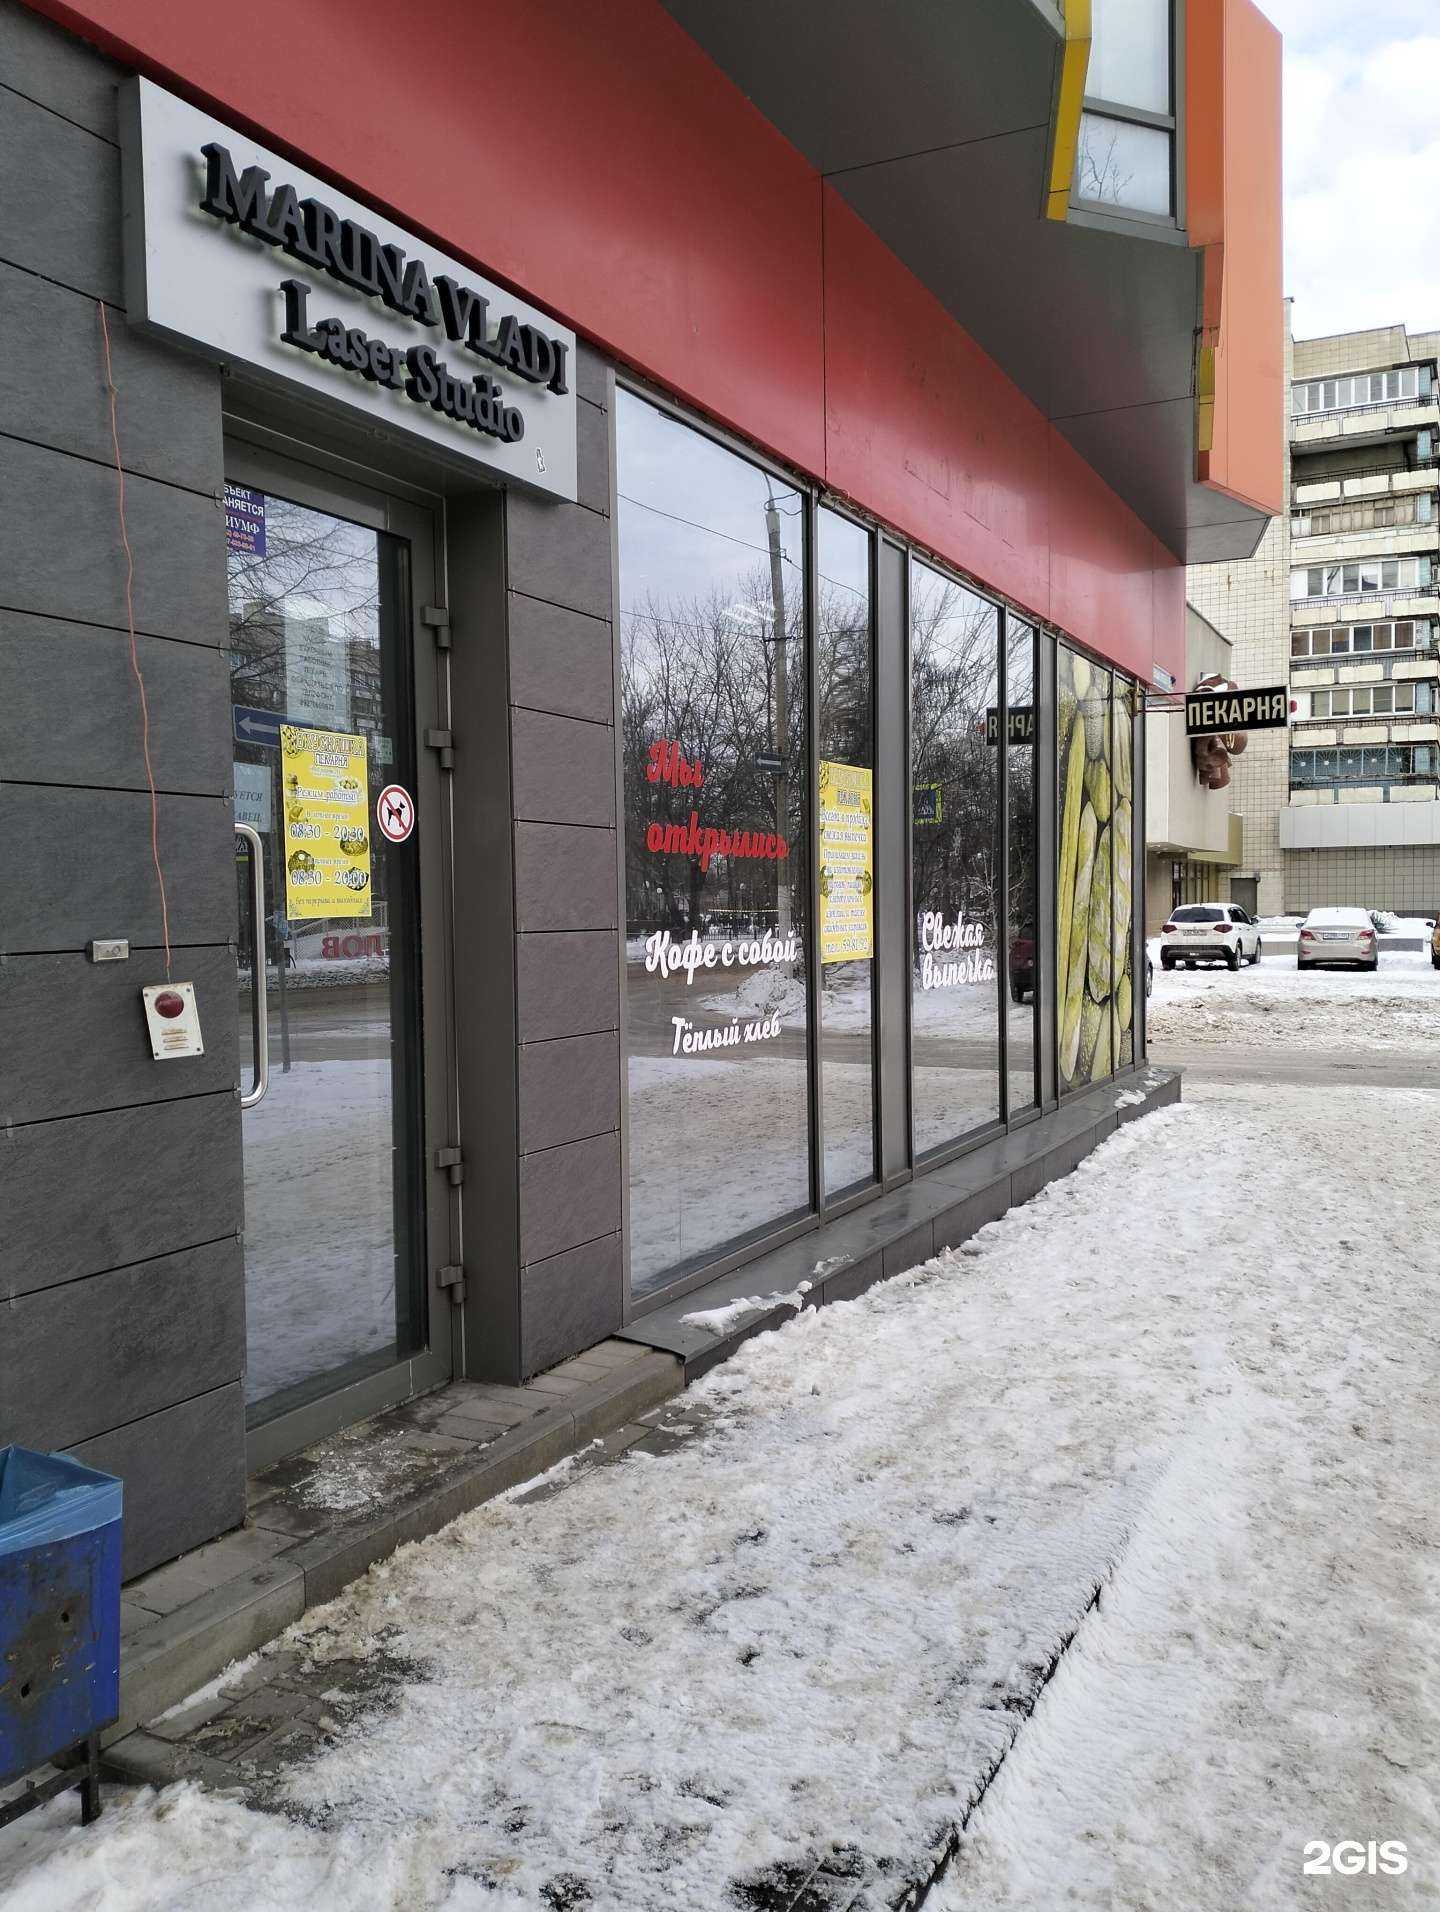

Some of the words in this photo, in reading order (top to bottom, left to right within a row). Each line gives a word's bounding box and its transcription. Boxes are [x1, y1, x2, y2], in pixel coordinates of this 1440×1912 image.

[280, 279, 406, 390] Laser
[405, 345, 525, 443] Studio
[1188, 694, 1285, 726] ПЕКАРНЯ
[646, 738, 705, 788] Мы
[290, 823, 321, 839] 08:30
[646, 811, 790, 873] открылись
[922, 911, 985, 951] Свежая
[645, 929, 718, 985] Кофе
[721, 942, 735, 967] с
[738, 928, 798, 966] собой
[672, 1016, 741, 1055] Тёплый
[744, 1009, 782, 1043] хлеб
